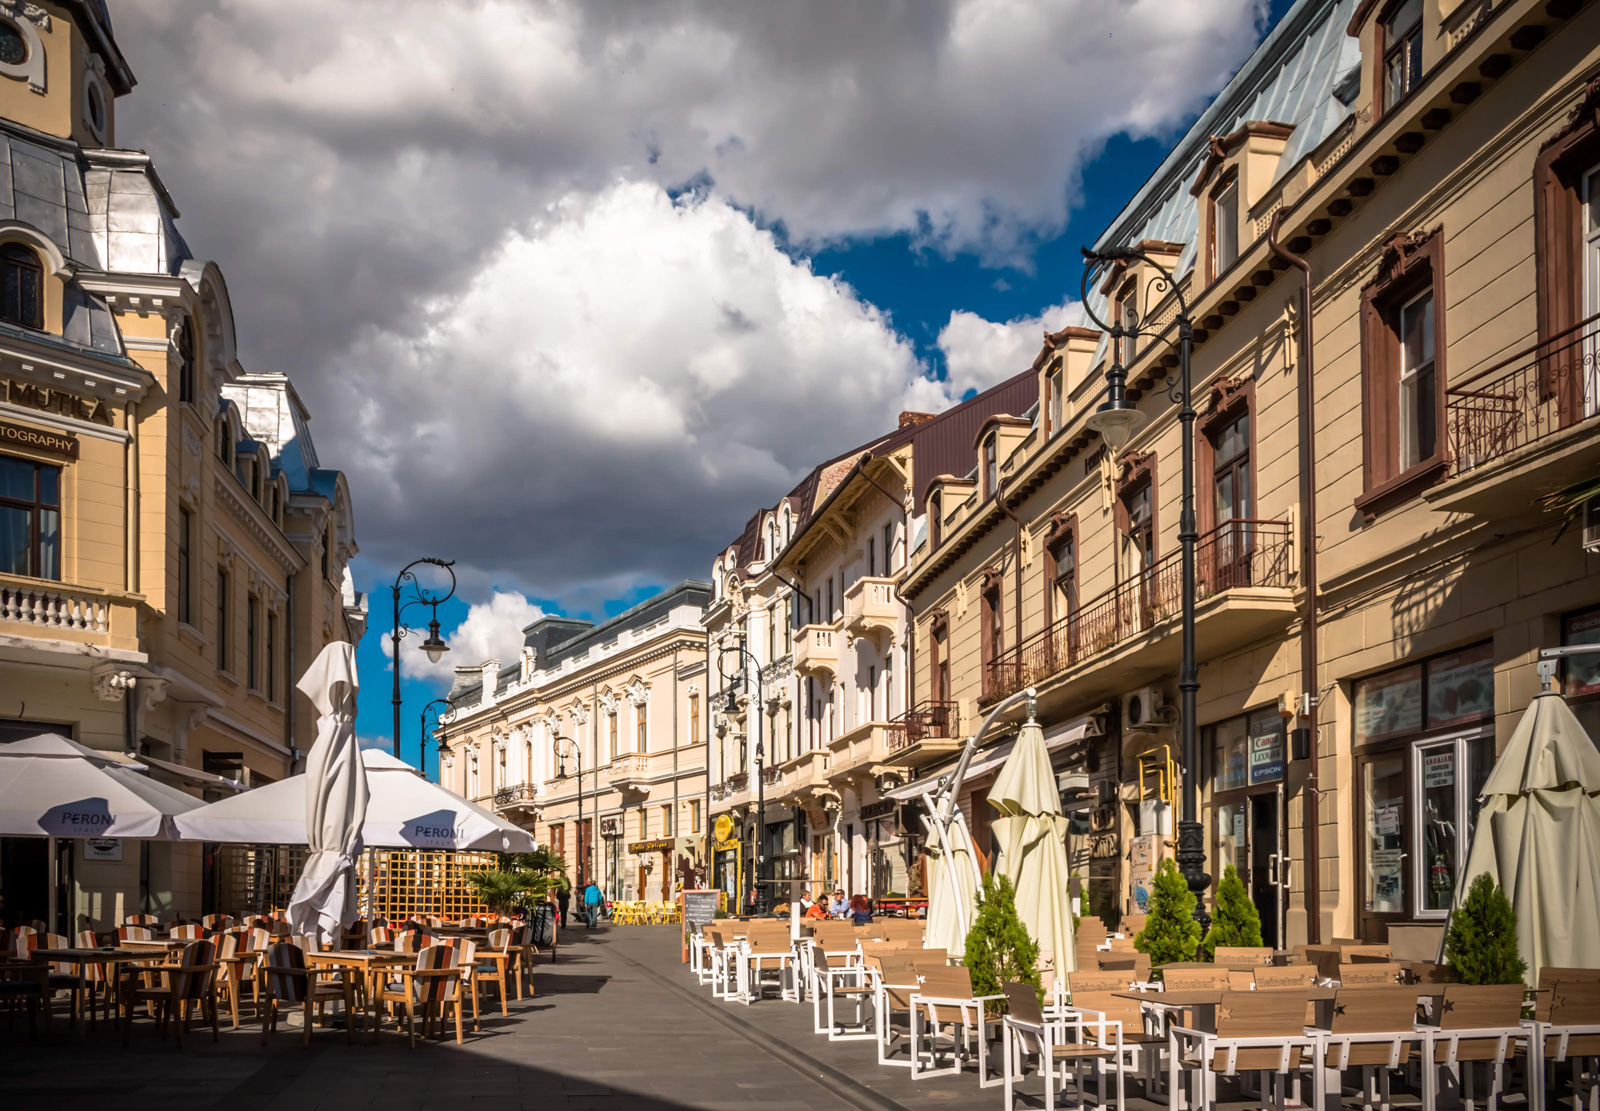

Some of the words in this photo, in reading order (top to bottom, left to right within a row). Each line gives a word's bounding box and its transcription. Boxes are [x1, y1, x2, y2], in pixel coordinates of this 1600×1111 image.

[1255, 737, 1279, 748] Canon
[1254, 766, 1281, 777] EPSON
[62, 812, 117, 825] PERONI
[415, 826, 464, 838] PERONI
